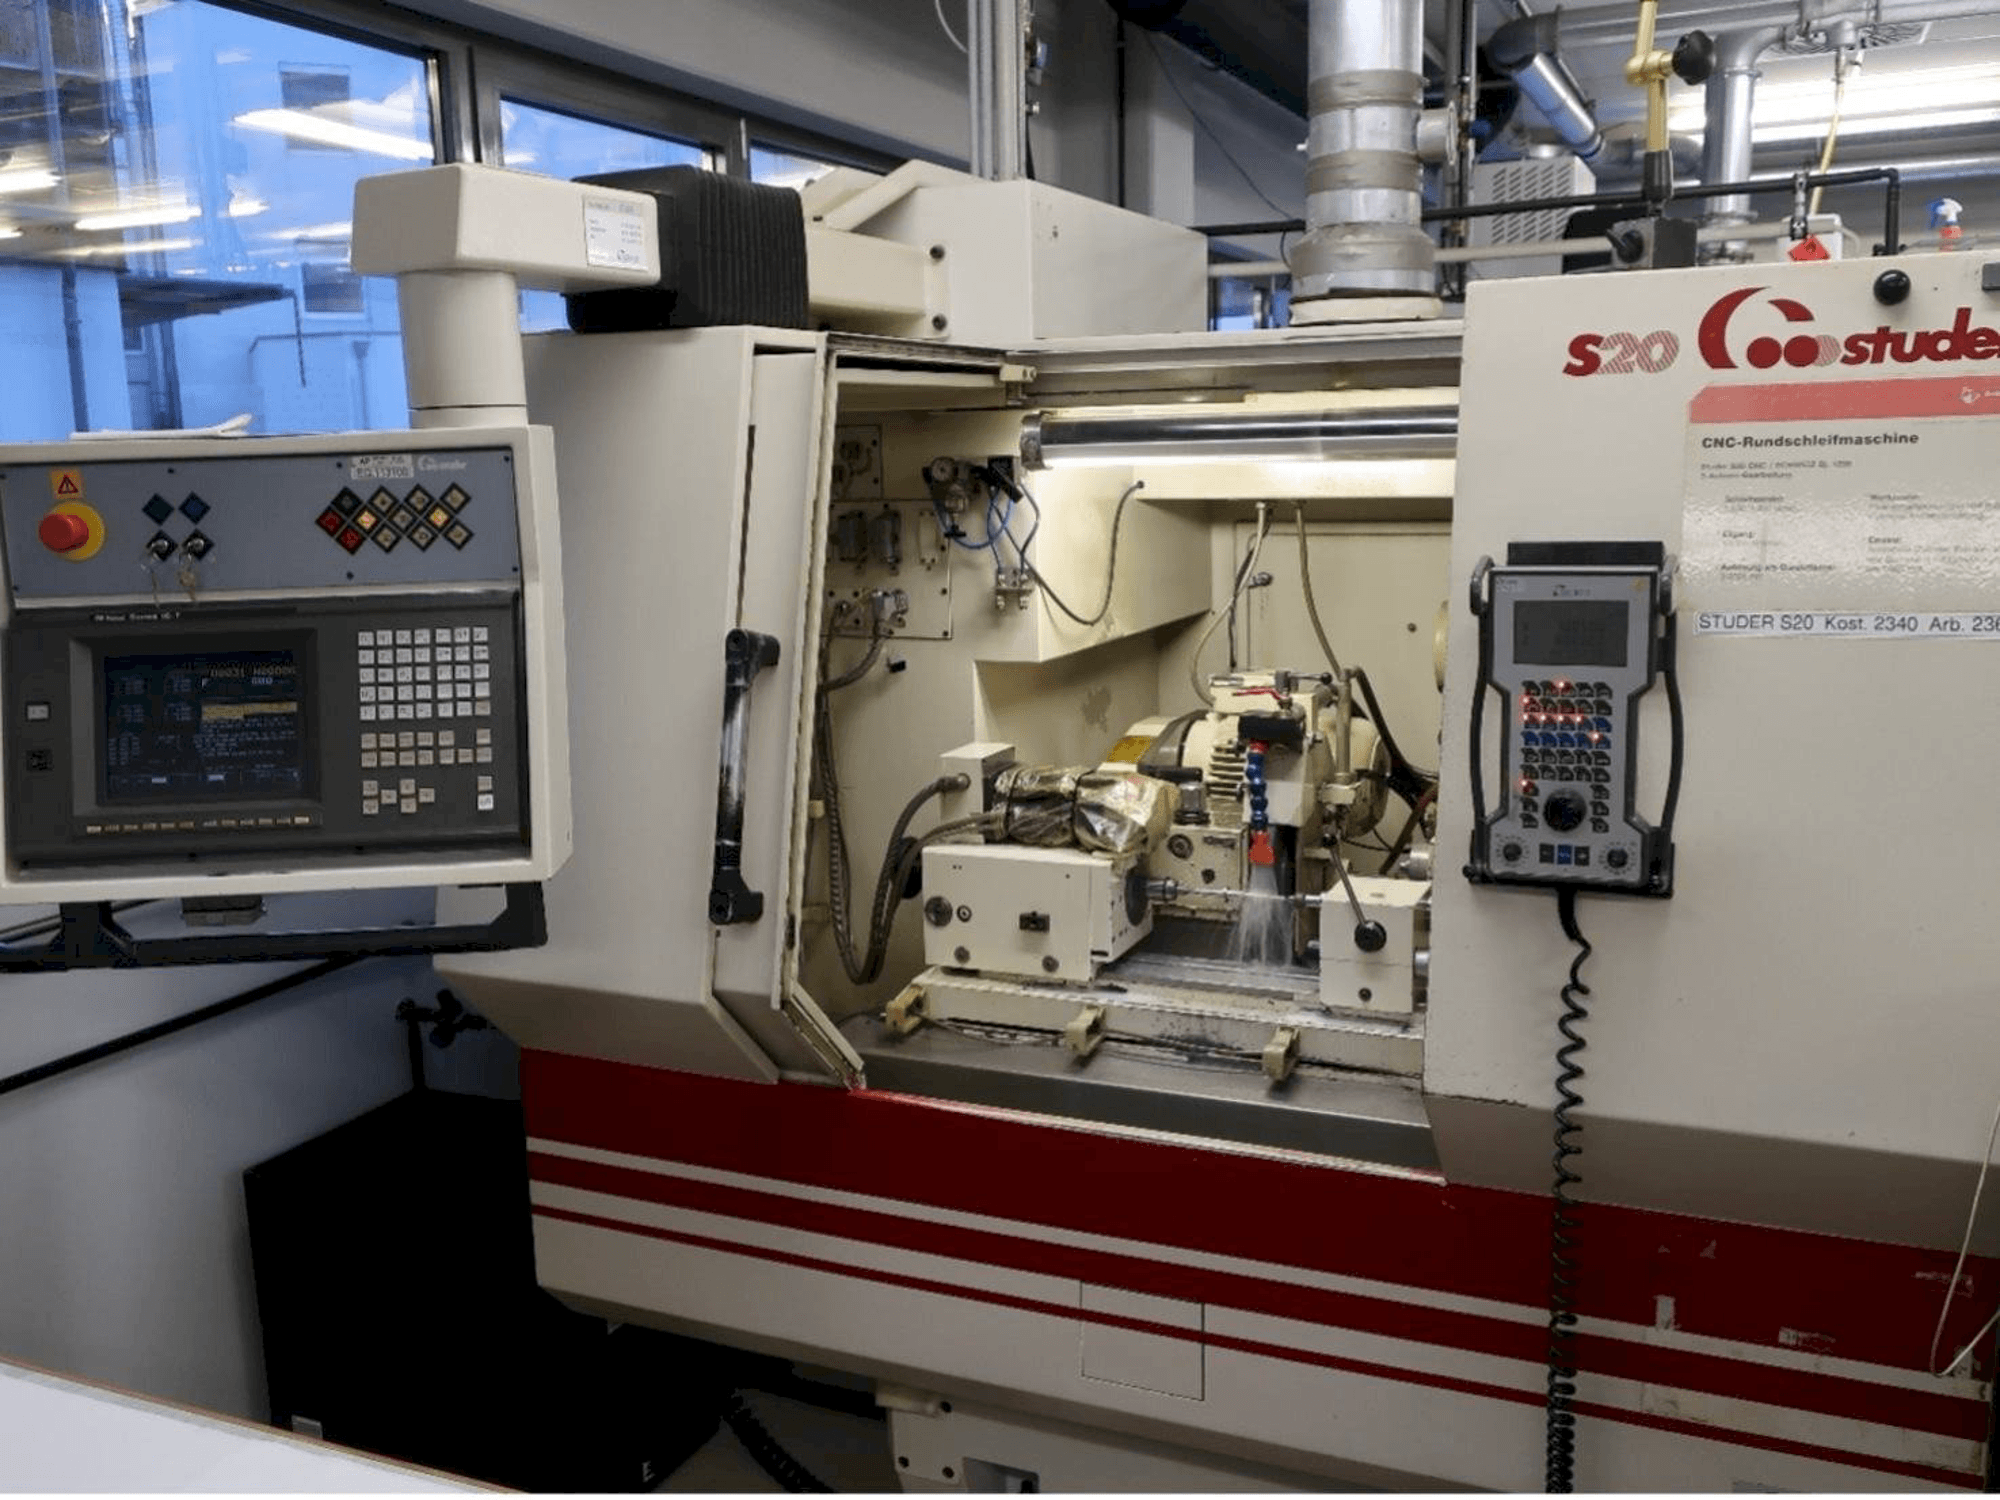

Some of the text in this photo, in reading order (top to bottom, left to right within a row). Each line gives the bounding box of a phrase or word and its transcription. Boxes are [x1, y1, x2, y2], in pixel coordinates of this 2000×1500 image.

[1562, 329, 1681, 377] S20
[1839, 307, 2000, 366] stude
[1702, 432, 1920, 450] CNC-Rundschleifmaschine
[1699, 613, 1775, 630] STUDER
[1780, 613, 1814, 631] S20
[1825, 615, 1867, 631] Kost.
[1874, 615, 1919, 632] 2340
[1929, 616, 1965, 632] Arb.
